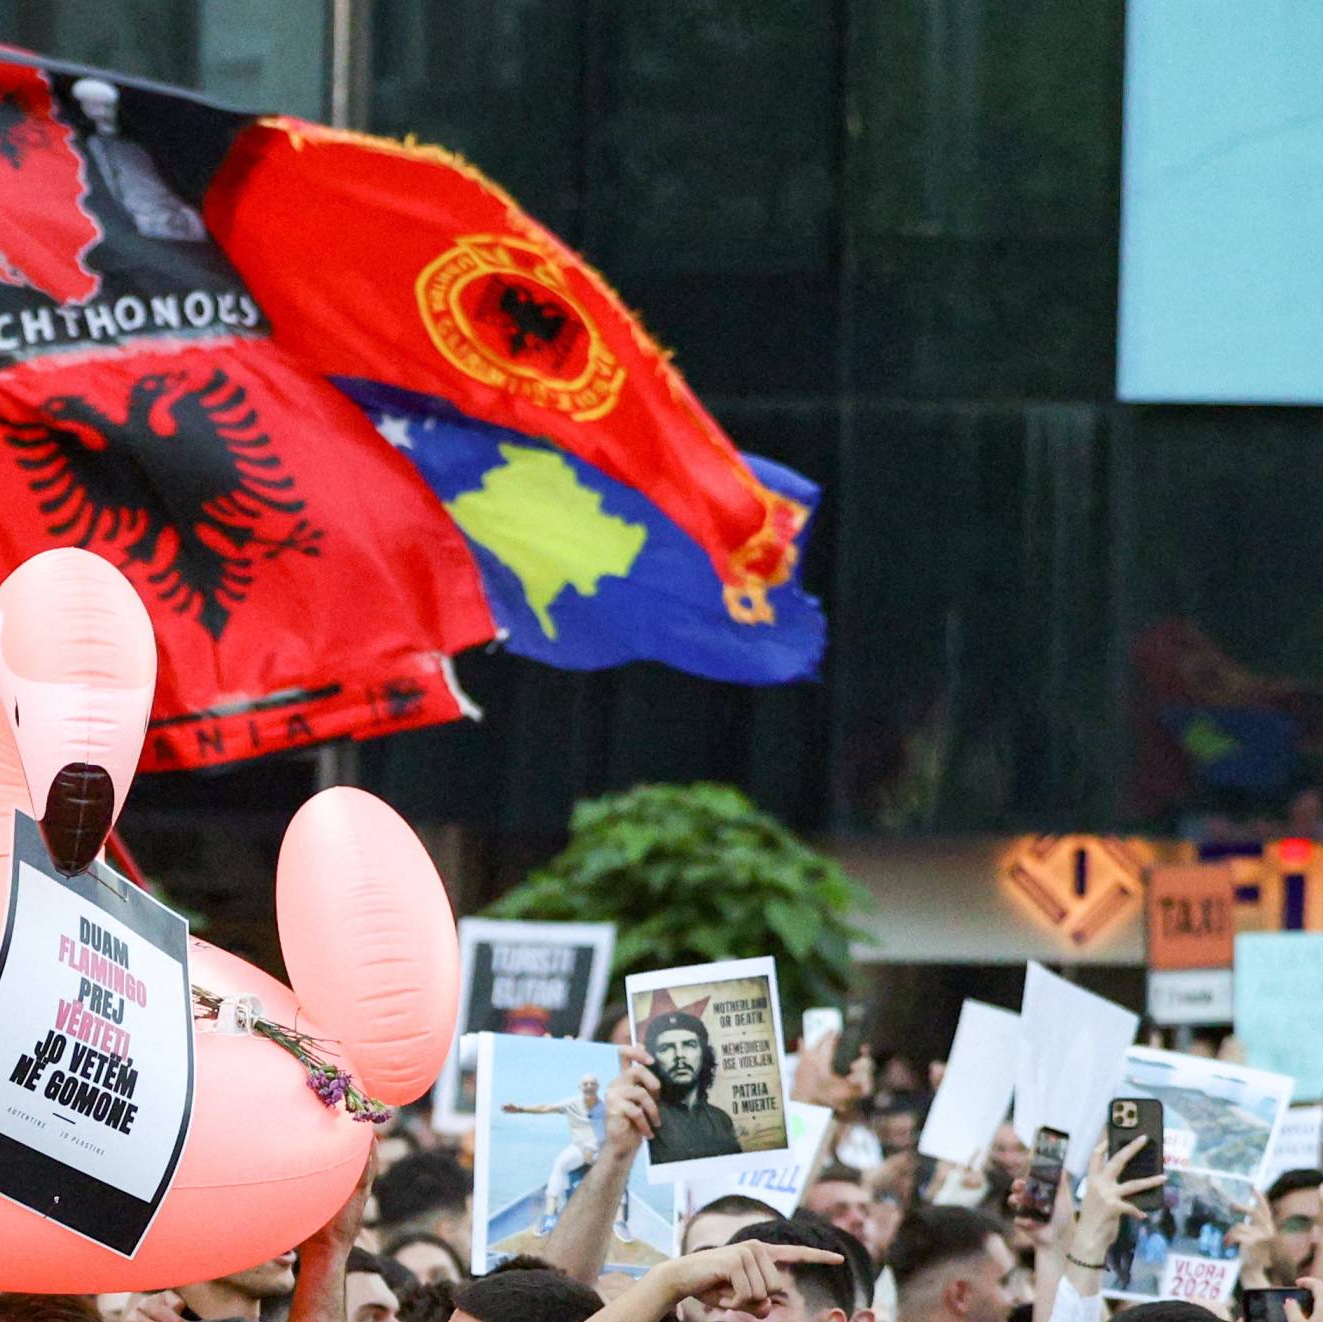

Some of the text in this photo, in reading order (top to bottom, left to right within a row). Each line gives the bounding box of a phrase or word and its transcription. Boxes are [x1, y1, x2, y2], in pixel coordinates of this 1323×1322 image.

[58, 934, 147, 1008] FLAMINGO
[80, 916, 130, 970] DUAM
[78, 977, 125, 1025] PREJ
[9, 1053, 139, 1135] NË GOMONE
[34, 1029, 139, 1100] JO VETËM
[732, 1081, 769, 1099] PATRIA
